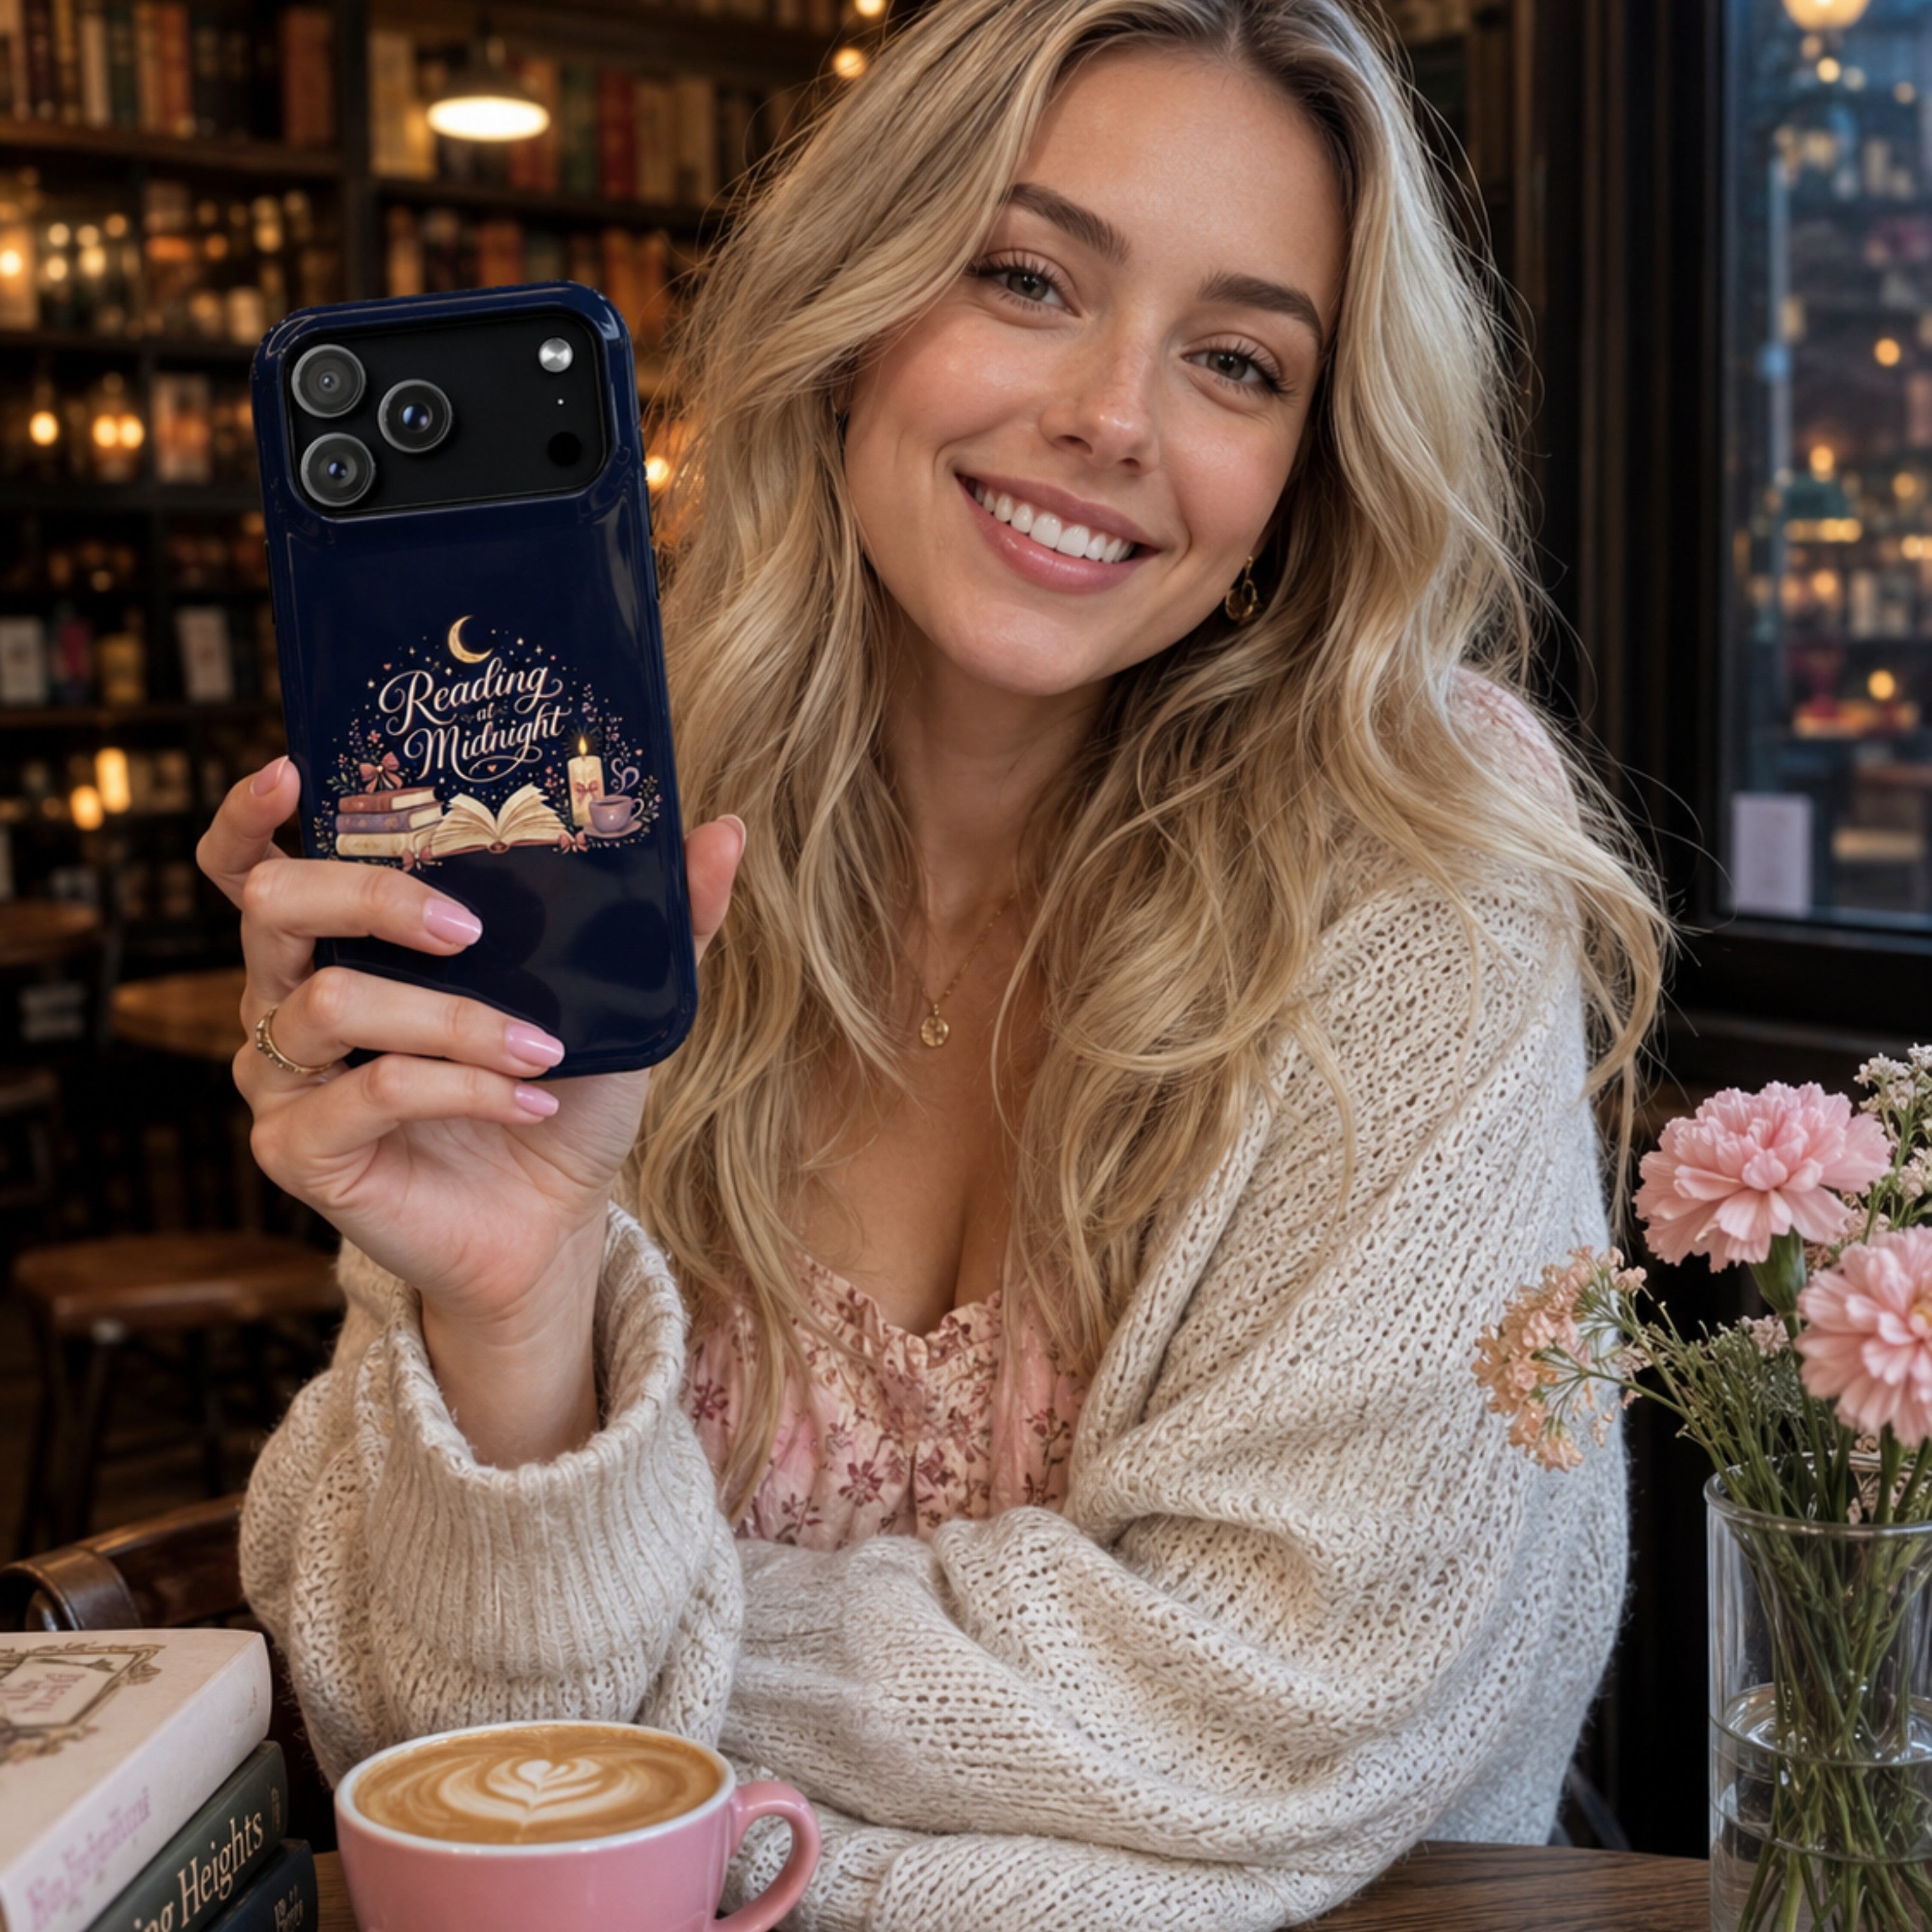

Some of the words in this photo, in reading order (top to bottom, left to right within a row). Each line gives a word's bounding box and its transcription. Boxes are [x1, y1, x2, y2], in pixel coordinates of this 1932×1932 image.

[378, 657, 564, 735] Reading
[477, 702, 495, 722] at
[403, 702, 572, 782] Midnight
[177, 1812, 264, 1928] Heights
